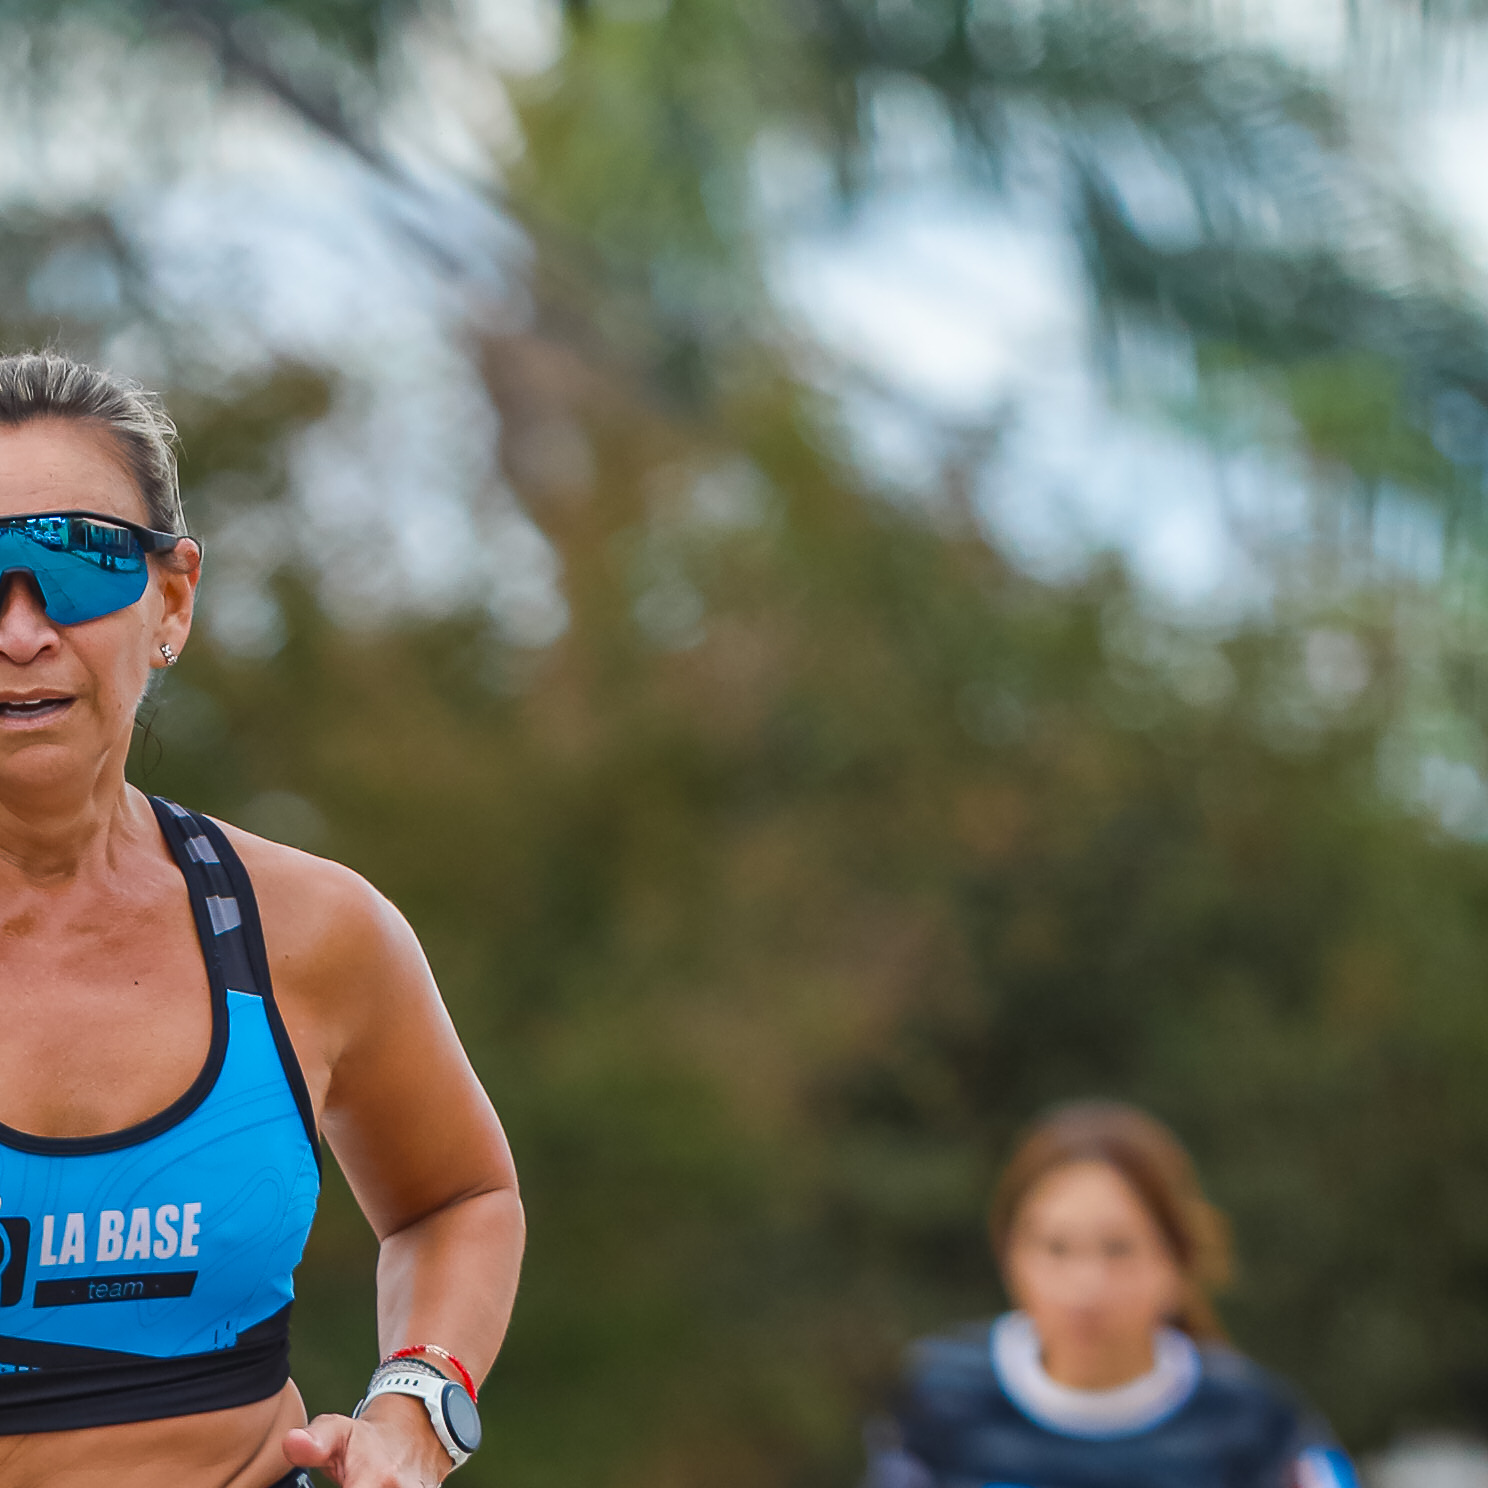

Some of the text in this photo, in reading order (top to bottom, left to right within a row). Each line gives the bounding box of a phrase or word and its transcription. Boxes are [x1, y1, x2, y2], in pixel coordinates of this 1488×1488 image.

[39, 1202, 202, 1266] LA BASE
[87, 1280, 144, 1300] team
